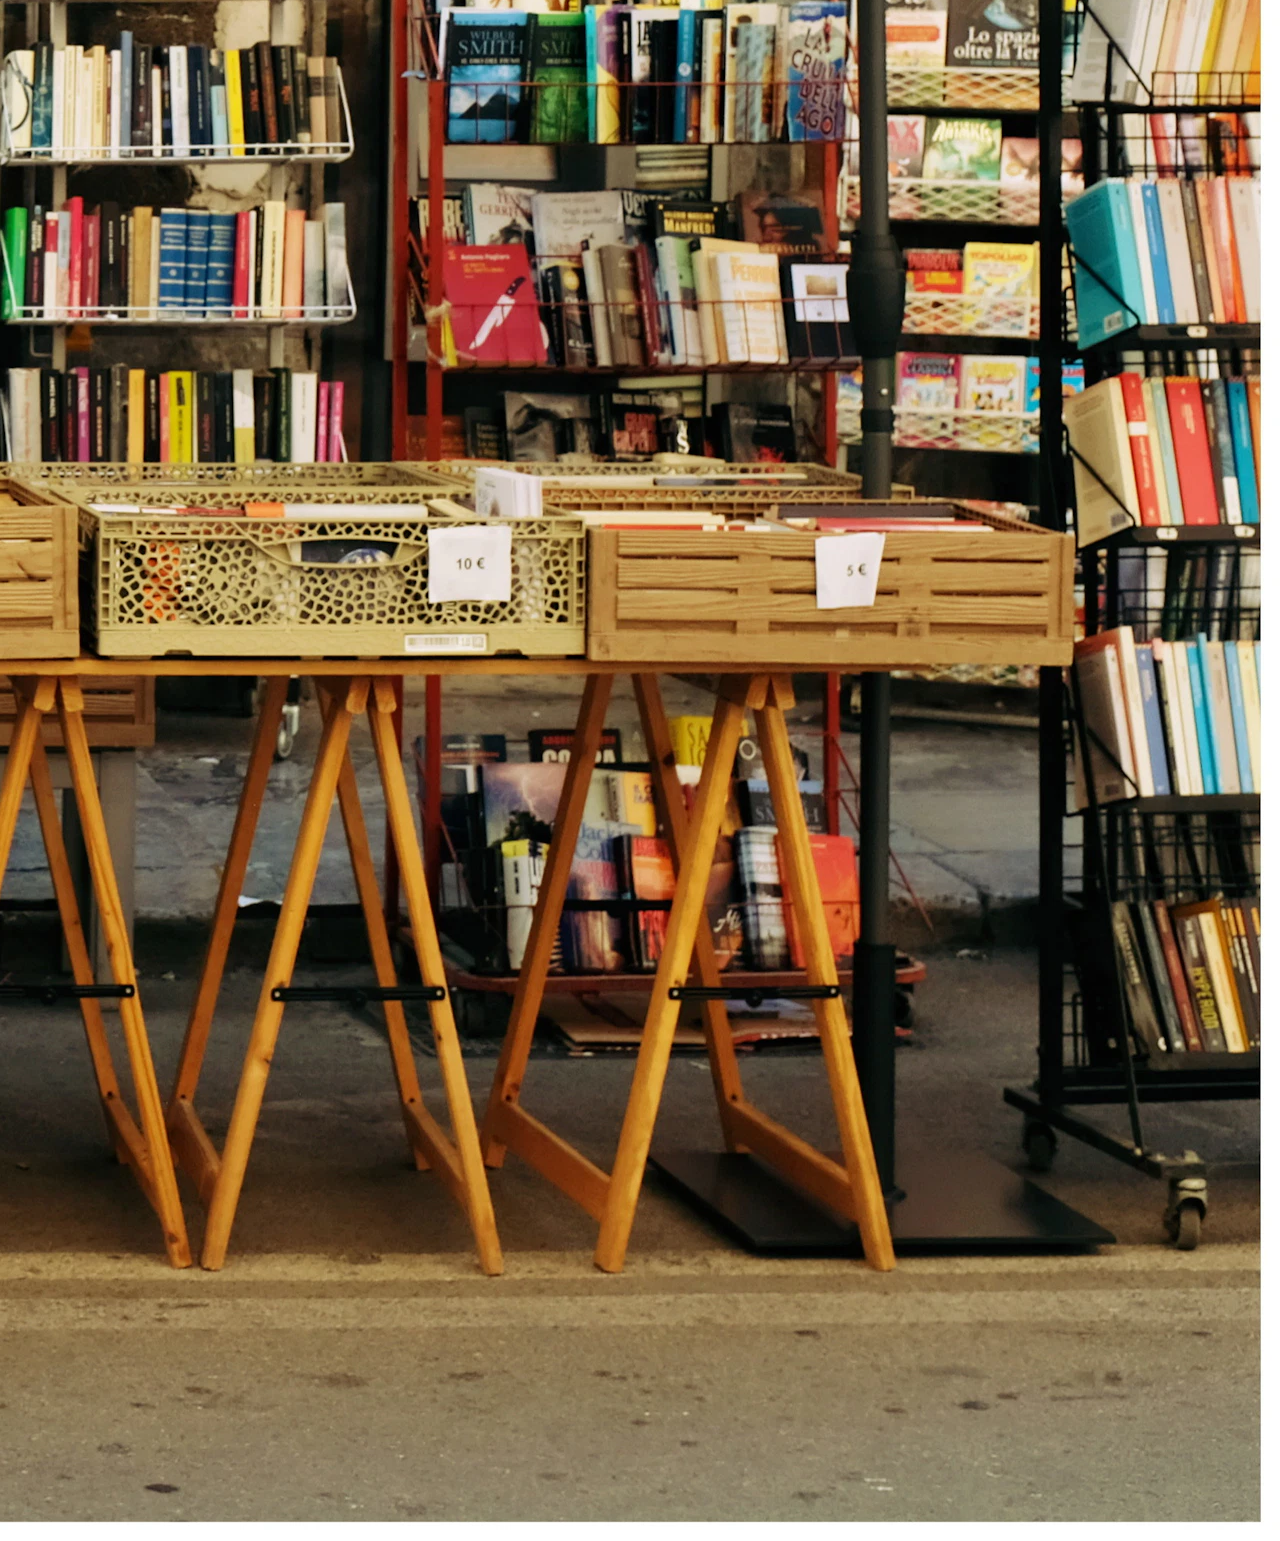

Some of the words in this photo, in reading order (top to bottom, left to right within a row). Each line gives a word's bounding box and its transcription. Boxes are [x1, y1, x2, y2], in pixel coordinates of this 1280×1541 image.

[469, 30, 516, 40] WILBUR
[968, 25, 990, 43] Lo
[458, 40, 524, 55] SMITH
[953, 42, 993, 59] oltre
[664, 220, 716, 235] MANFREDI
[456, 557, 472, 570] 10
[476, 557, 486, 570] €
[846, 564, 854, 577] 5
[857, 564, 868, 577] €
[1191, 965, 1220, 1031] HYPERION
